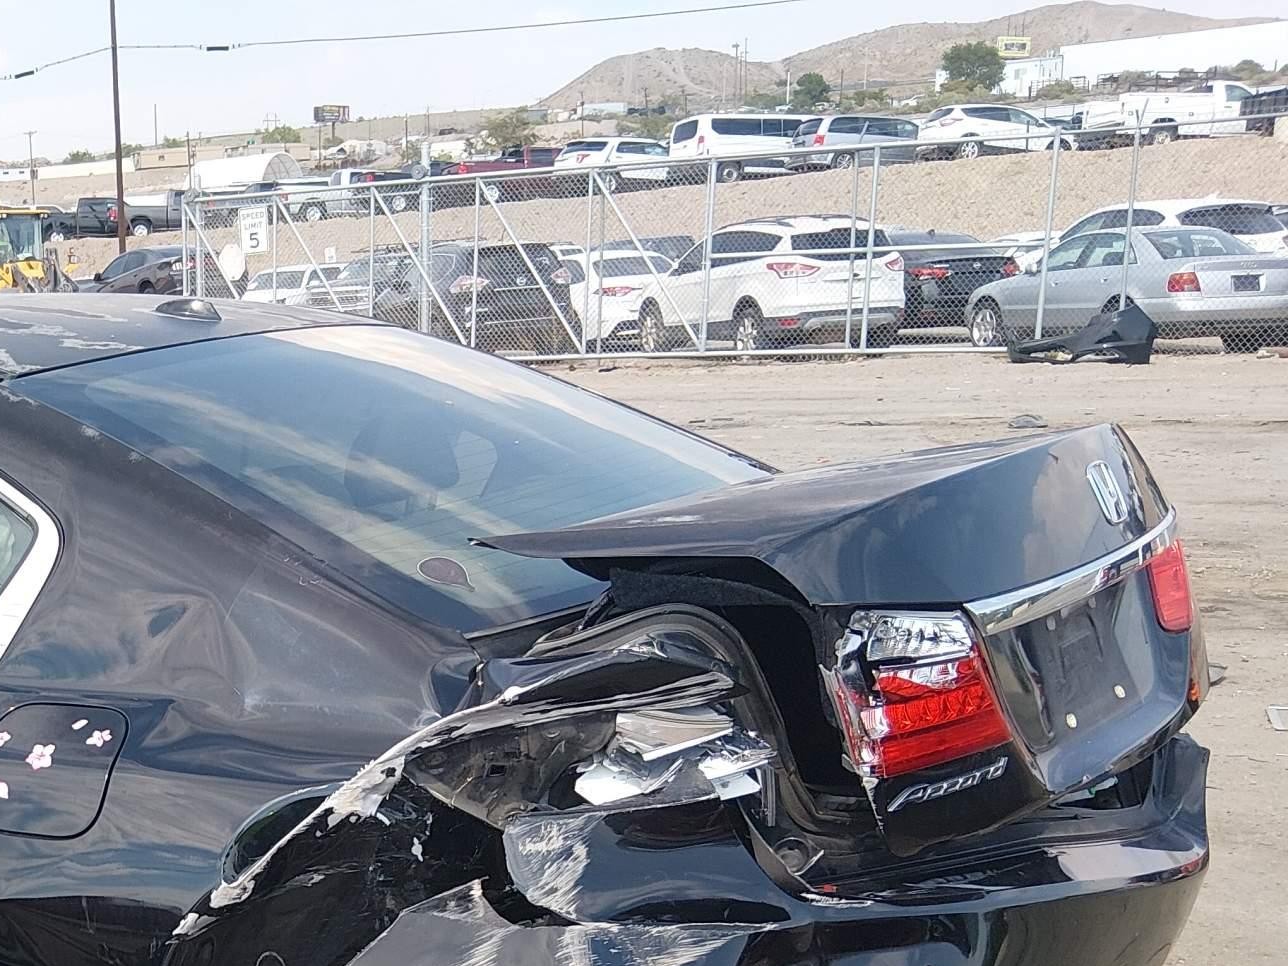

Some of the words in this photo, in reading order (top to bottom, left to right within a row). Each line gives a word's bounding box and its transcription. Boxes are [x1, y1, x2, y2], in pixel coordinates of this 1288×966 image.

[241, 211, 265, 221] SPEED
[243, 219, 263, 231] LIMIT
[249, 232, 260, 249] 5
